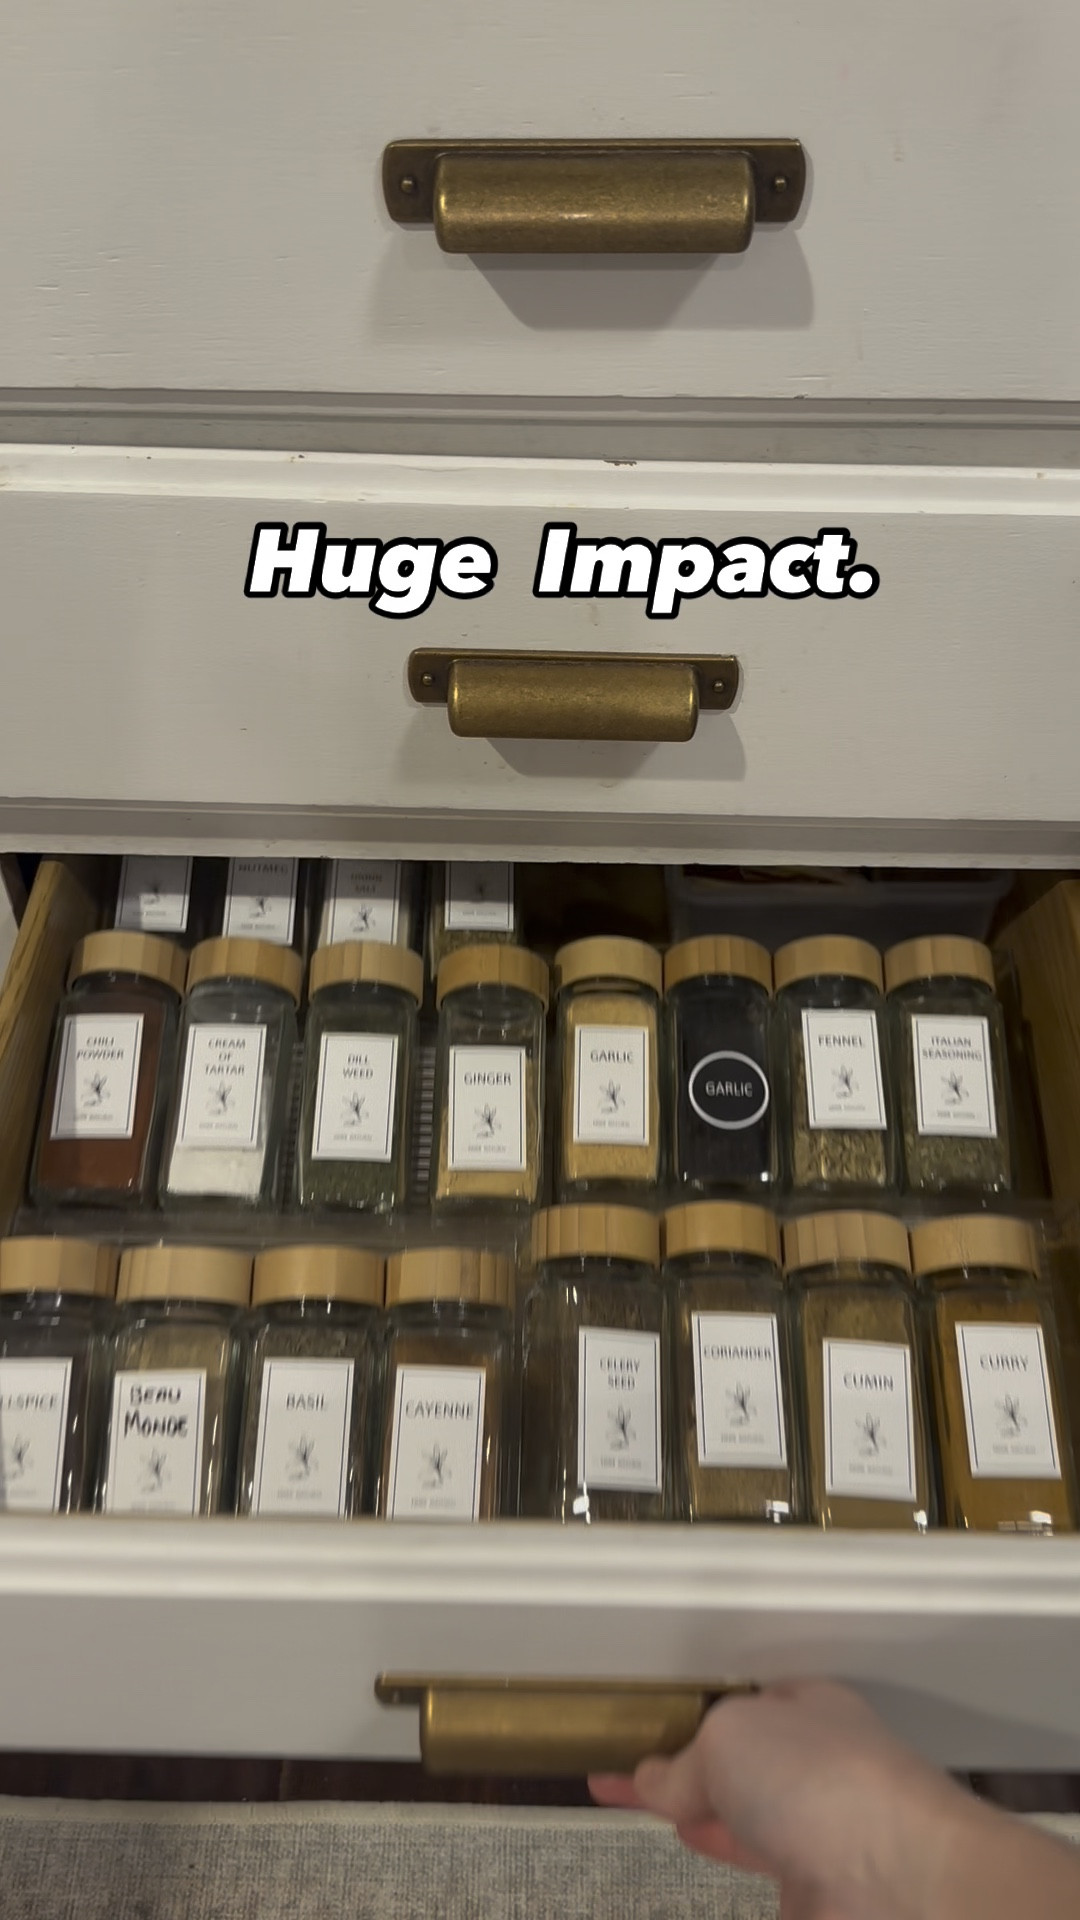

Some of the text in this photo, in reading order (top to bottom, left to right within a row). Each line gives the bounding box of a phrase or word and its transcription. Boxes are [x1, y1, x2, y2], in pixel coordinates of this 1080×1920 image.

[238, 862, 289, 875] NUTMEG
[86, 1036, 115, 1047] CHILI
[208, 1038, 246, 1050] CREAM
[818, 1034, 864, 1048] FENNEL
[931, 1036, 972, 1048] ITALIAN
[76, 1050, 124, 1061] POWDER
[218, 1052, 233, 1062] OF
[347, 1053, 369, 1065] DILL
[590, 1050, 634, 1064] GARLIC
[922, 1051, 982, 1062] SEASONING
[205, 1064, 245, 1076] TARTAR
[343, 1067, 374, 1080] WEED
[464, 1072, 512, 1086] GINGER
[705, 1080, 753, 1098] GARLIC
[704, 1344, 772, 1361] CORIANDER
[600, 1356, 641, 1374] CELERY
[979, 1354, 1029, 1372] CURRY
[607, 1374, 636, 1391] SEED
[843, 1374, 894, 1392] CUMIN
[286, 1393, 327, 1412] BASIL
[405, 1401, 473, 1421] CAYENNE
